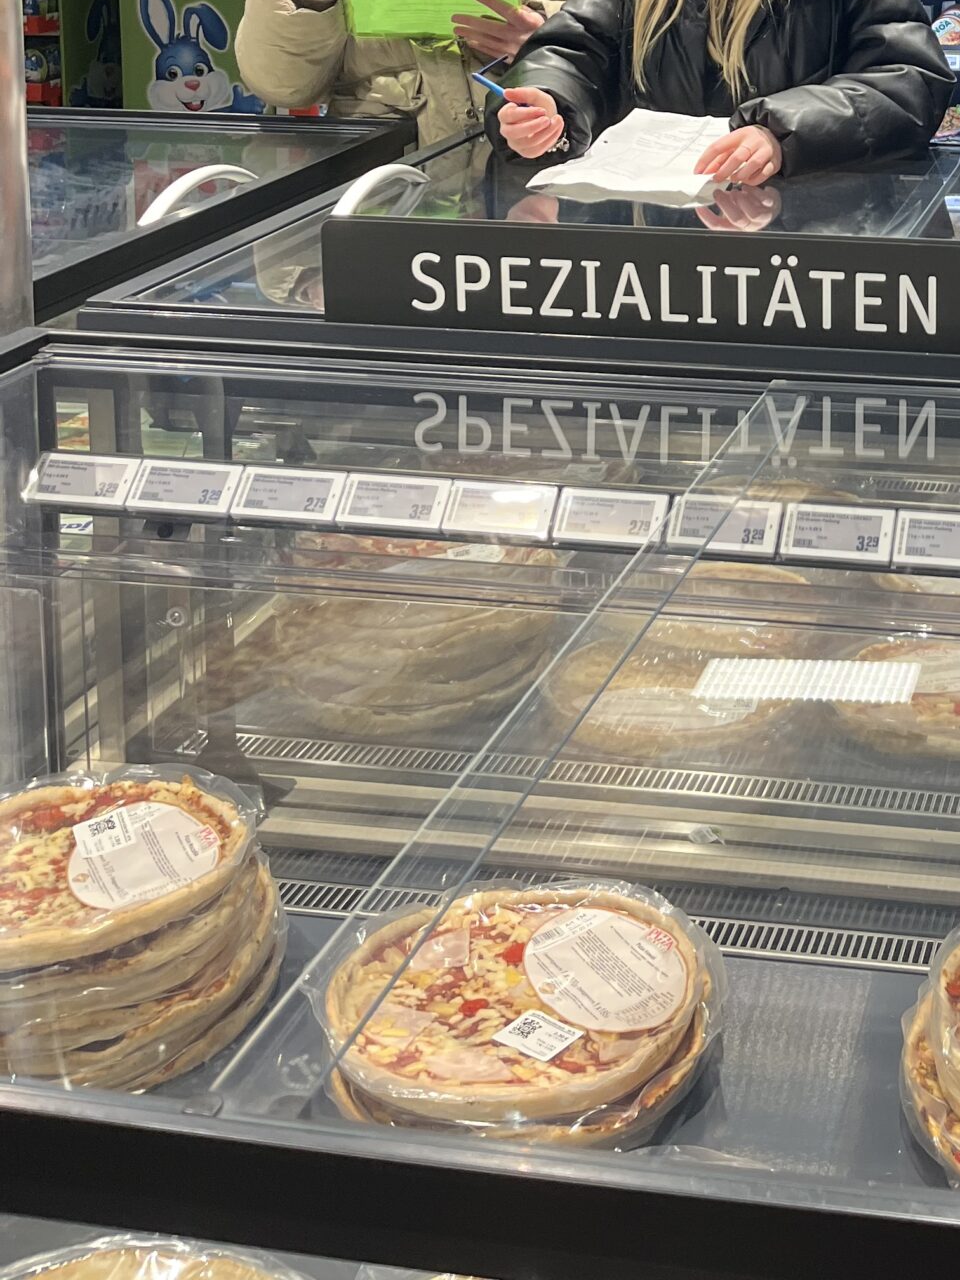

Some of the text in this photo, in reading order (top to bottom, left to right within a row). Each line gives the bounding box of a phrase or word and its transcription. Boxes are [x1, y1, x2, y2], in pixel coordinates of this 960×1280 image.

[411, 252, 938, 334] SPEZIALITÄTEN
[198, 488, 222, 505] 3.29
[303, 497, 327, 512] 2.79
[409, 503, 433, 520] 3.29
[742, 528, 764, 545] 3.29
[856, 535, 879, 551] 3.29
[646, 927, 674, 951] PIZZA
